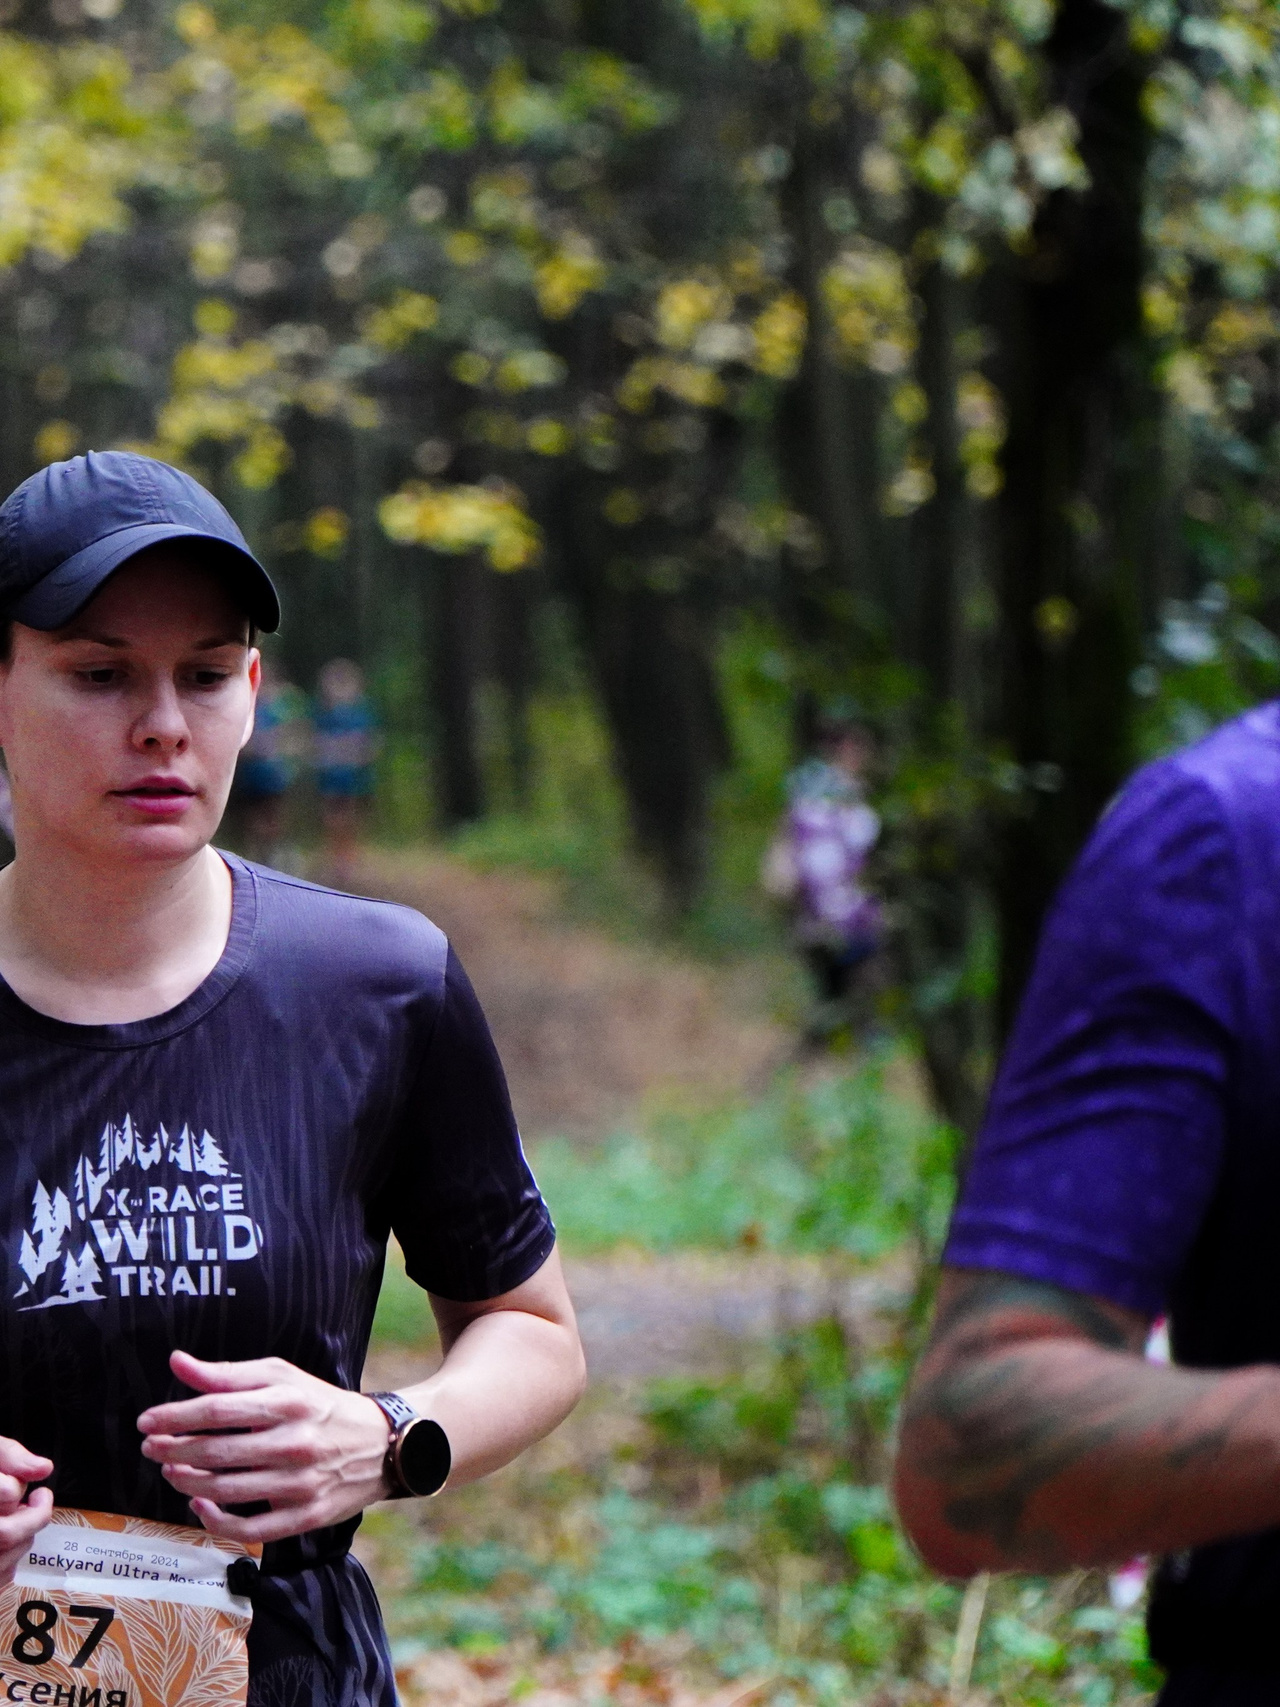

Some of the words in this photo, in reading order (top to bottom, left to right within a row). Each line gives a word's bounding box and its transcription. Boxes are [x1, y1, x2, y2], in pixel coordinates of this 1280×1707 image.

[90, 1214, 263, 1262] WILD
[28, 1552, 102, 1574] Backyard
[112, 1563, 160, 1582] Ultra
[63, 1540, 79, 1553] 28
[85, 1544, 144, 1562] сентября
[150, 1553, 179, 1569] 2024
[11, 1600, 116, 1668] 87
